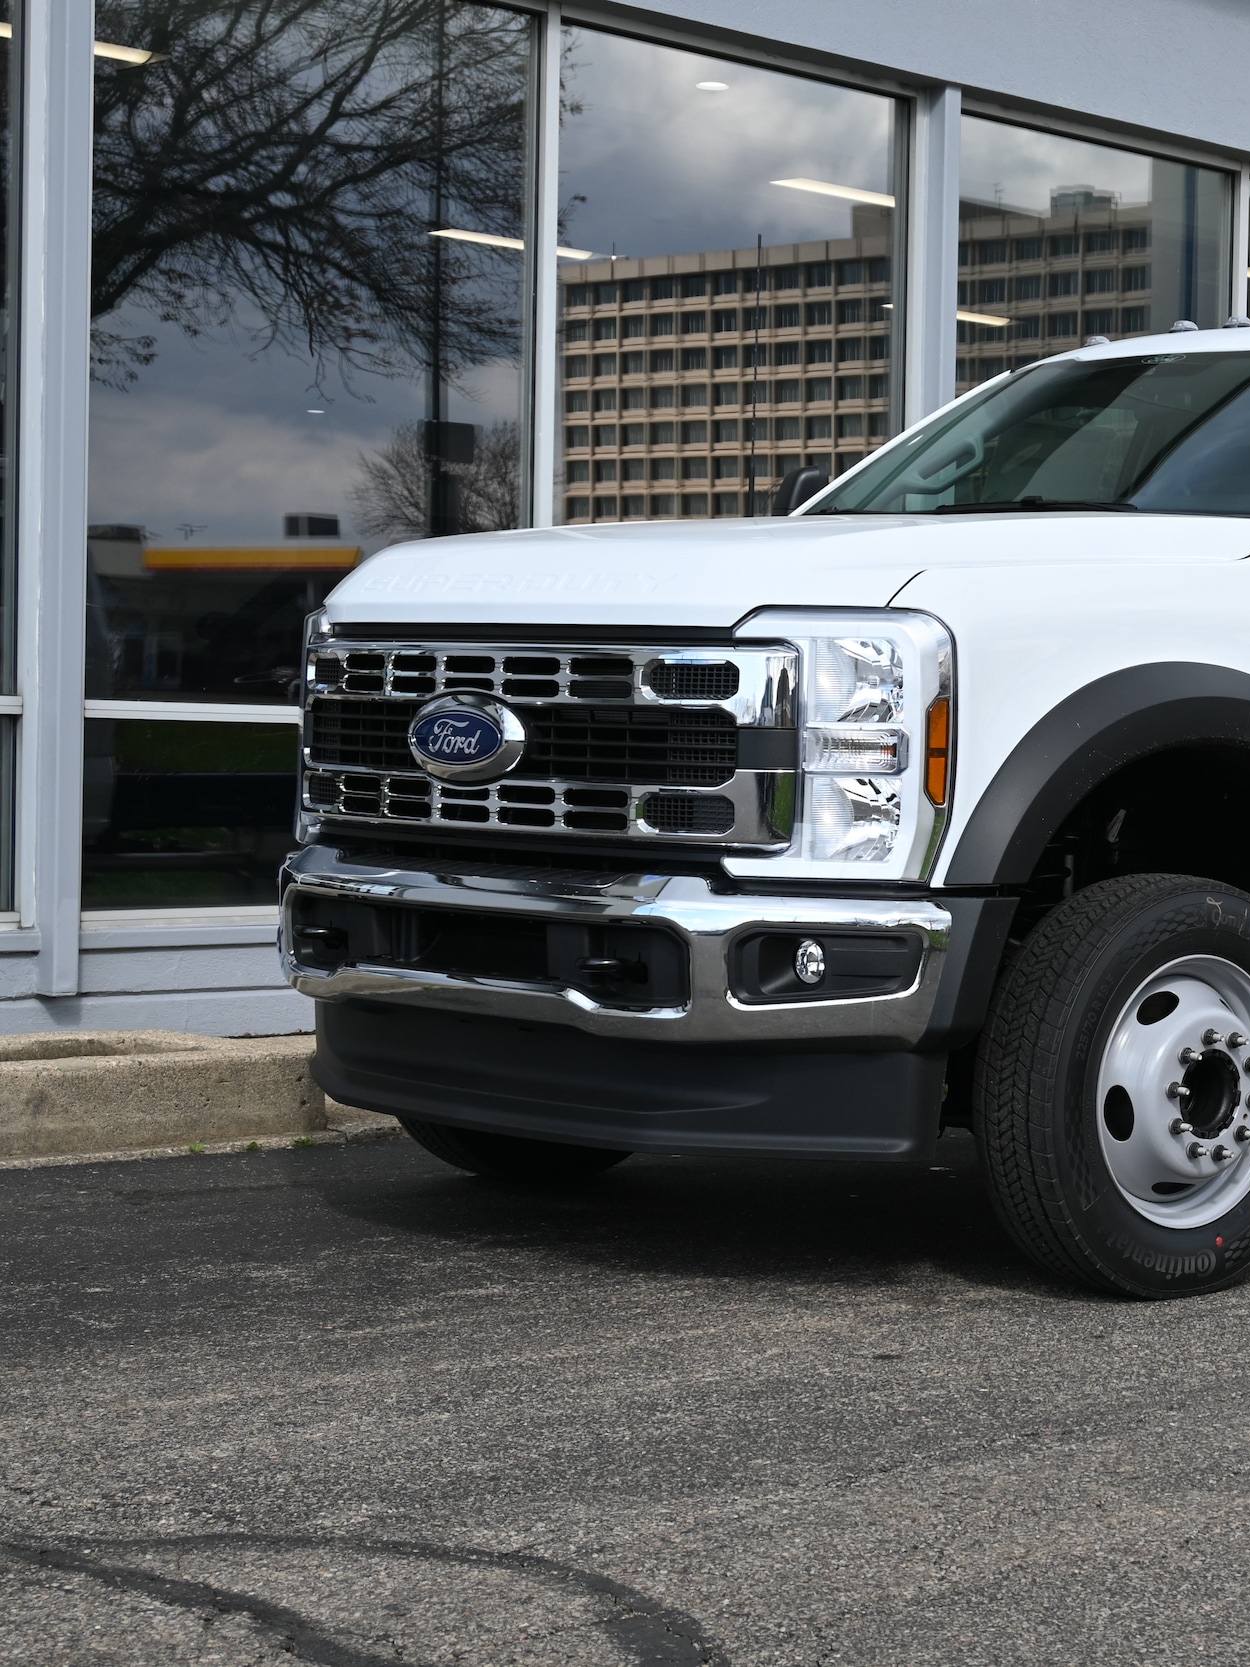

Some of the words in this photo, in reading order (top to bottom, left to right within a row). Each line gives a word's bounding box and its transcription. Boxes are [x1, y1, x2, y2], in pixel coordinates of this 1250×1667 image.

[360, 574, 514, 592] SUPER
[516, 573, 678, 593] DUTY
[429, 718, 481, 754] Ford
[1105, 1231, 1217, 1280] Continental
